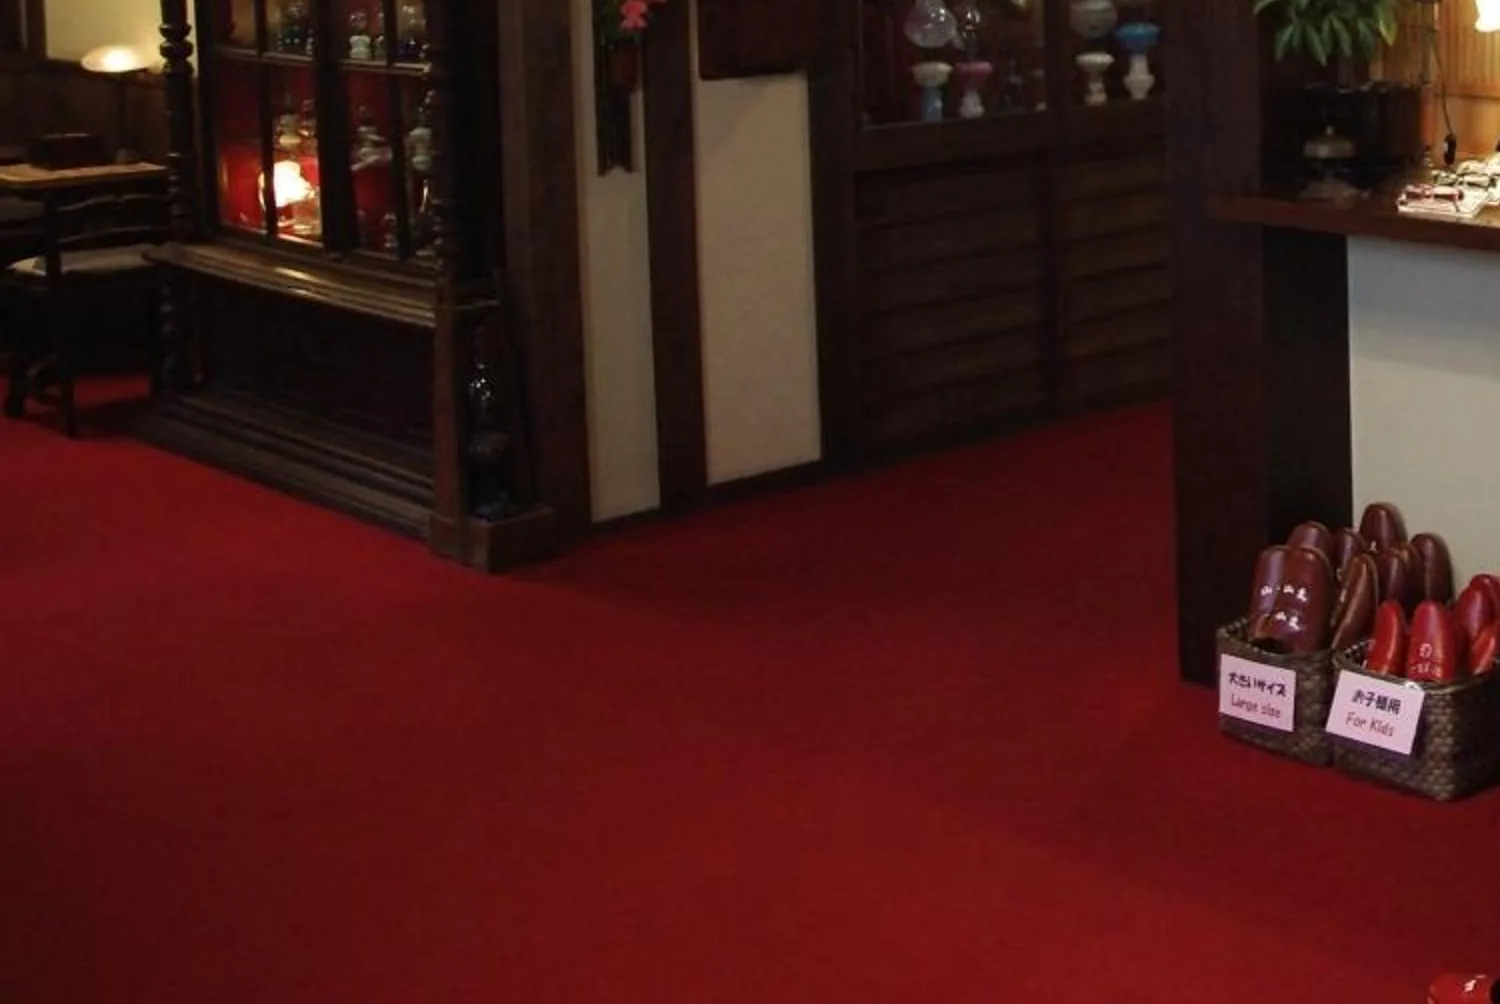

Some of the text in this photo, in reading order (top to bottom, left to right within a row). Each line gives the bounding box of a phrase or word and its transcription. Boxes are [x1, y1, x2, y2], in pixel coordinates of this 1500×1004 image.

[1228, 671, 1288, 698] 大きいサイズ
[1231, 693, 1282, 719] Large size
[1351, 688, 1402, 716] お子様用
[1345, 711, 1396, 737] For Kids
